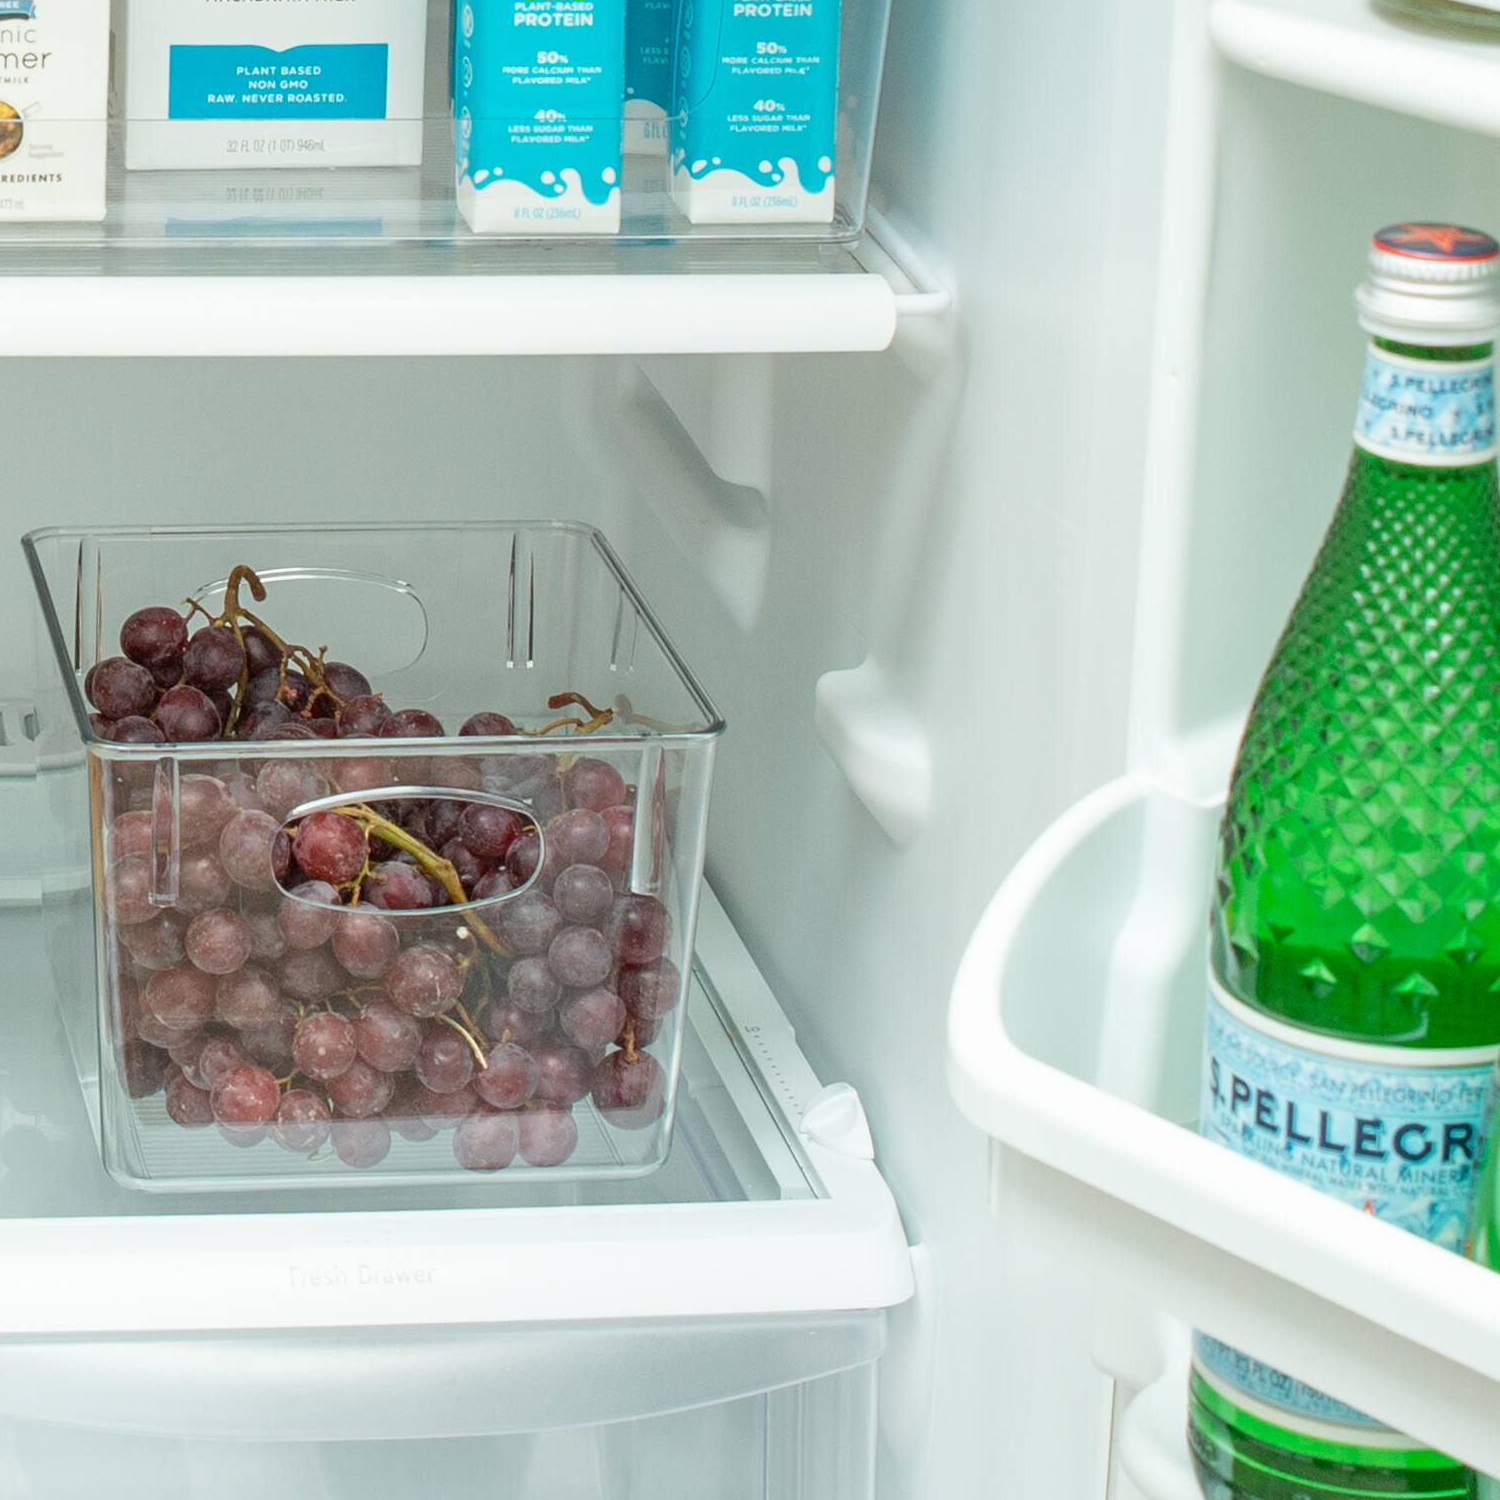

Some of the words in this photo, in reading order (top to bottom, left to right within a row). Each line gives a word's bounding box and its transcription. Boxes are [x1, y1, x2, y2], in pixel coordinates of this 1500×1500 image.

[514, 1, 594, 12] PLANT-BASED
[733, 3, 813, 18] PROTEIN
[513, 12, 594, 27] PROTEIN
[756, 41, 788, 55] 50%
[537, 51, 569, 65] 50%
[750, 56, 793, 64] CALCIUM
[236, 66, 277, 77] PLANT
[280, 66, 322, 76] BASED
[502, 65, 529, 75] MORE
[531, 65, 574, 75] CALCIUM
[576, 65, 602, 74] THAN
[731, 66, 782, 76] FLAVORED
[248, 80, 276, 90] NON
[280, 80, 309, 90] GMO
[511, 76, 563, 85] FLAVORED
[207, 93, 238, 104] RAW.
[242, 93, 284, 104] NEVER
[287, 92, 348, 104] ROASTED.
[753, 100, 786, 113] 40%
[534, 109, 567, 124] 40%
[726, 114, 749, 123] LESS
[752, 114, 784, 123] SUGAR
[786, 113, 811, 122] THAN
[507, 124, 531, 133] LESS
[533, 124, 565, 134] SUGAR
[567, 124, 593, 133] THAN
[729, 124, 779, 133] FLAVORED
[510, 134, 562, 144] FLAVORED
[226, 139, 238, 153] 32
[240, 140, 251, 151] FL
[253, 139, 266, 151] OZ
[287, 1264, 347, 1288] Fresh
[357, 1263, 435, 1285] Drawer
